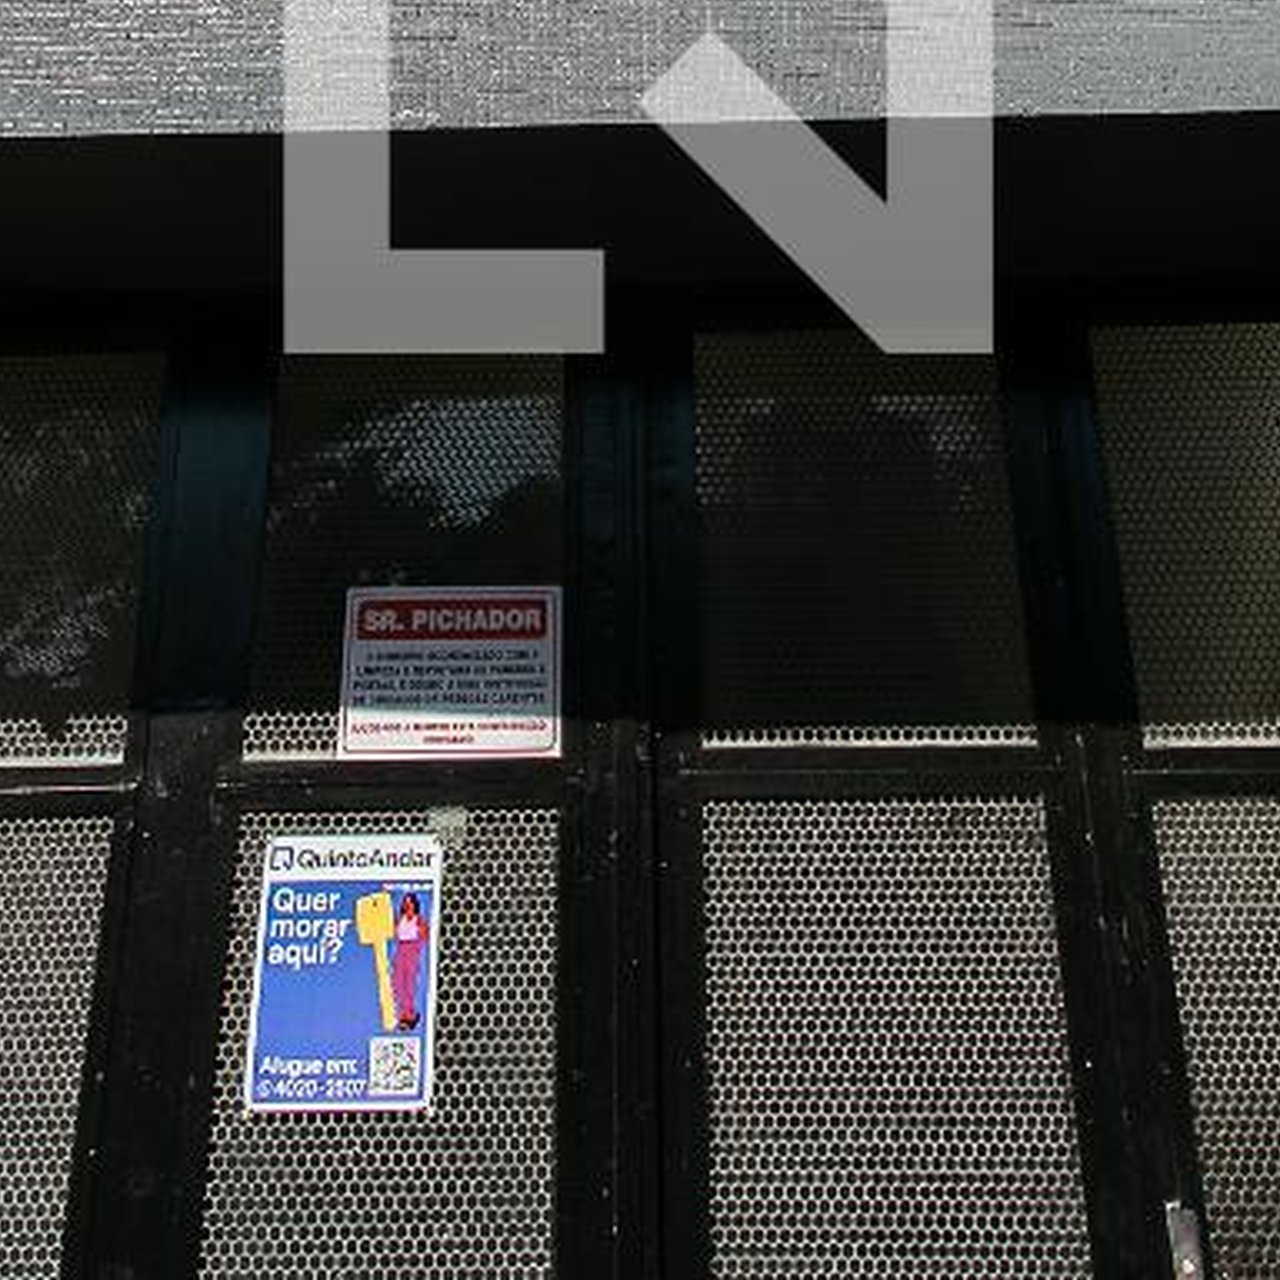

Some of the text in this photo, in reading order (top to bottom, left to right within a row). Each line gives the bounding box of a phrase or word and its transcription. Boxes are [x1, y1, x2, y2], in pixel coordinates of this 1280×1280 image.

[411, 608, 543, 632] PICHADOR
[296, 848, 433, 869] QuintoAndar
[272, 888, 341, 914] Quer
[270, 919, 352, 938] morar
[267, 938, 343, 970] aqui?
